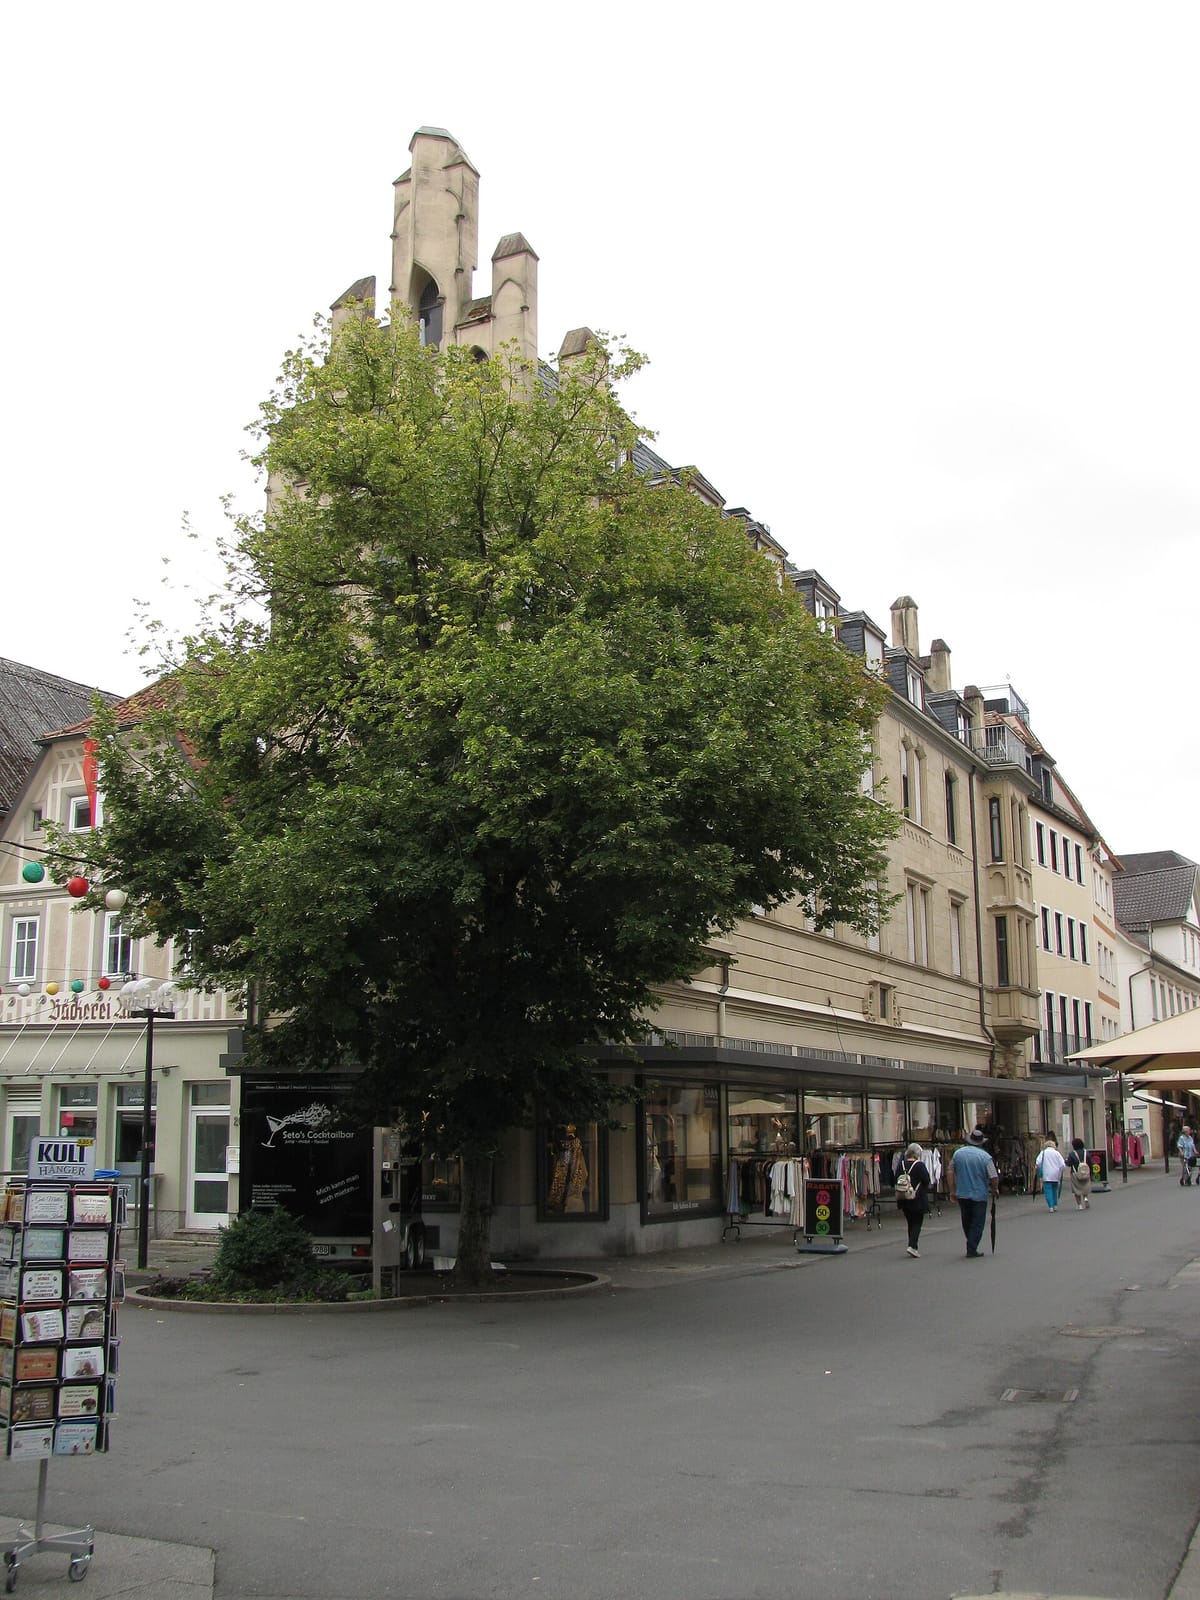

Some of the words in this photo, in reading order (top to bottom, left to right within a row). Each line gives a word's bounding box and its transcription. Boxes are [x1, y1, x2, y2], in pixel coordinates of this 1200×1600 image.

[49, 996, 111, 1020] Bäckerei
[282, 1130, 305, 1139] Seto's
[307, 1130, 355, 1139] Cocktailbar
[37, 1143, 86, 1162] KULT
[316, 1185, 331, 1196] Mich
[330, 1180, 346, 1190] kann
